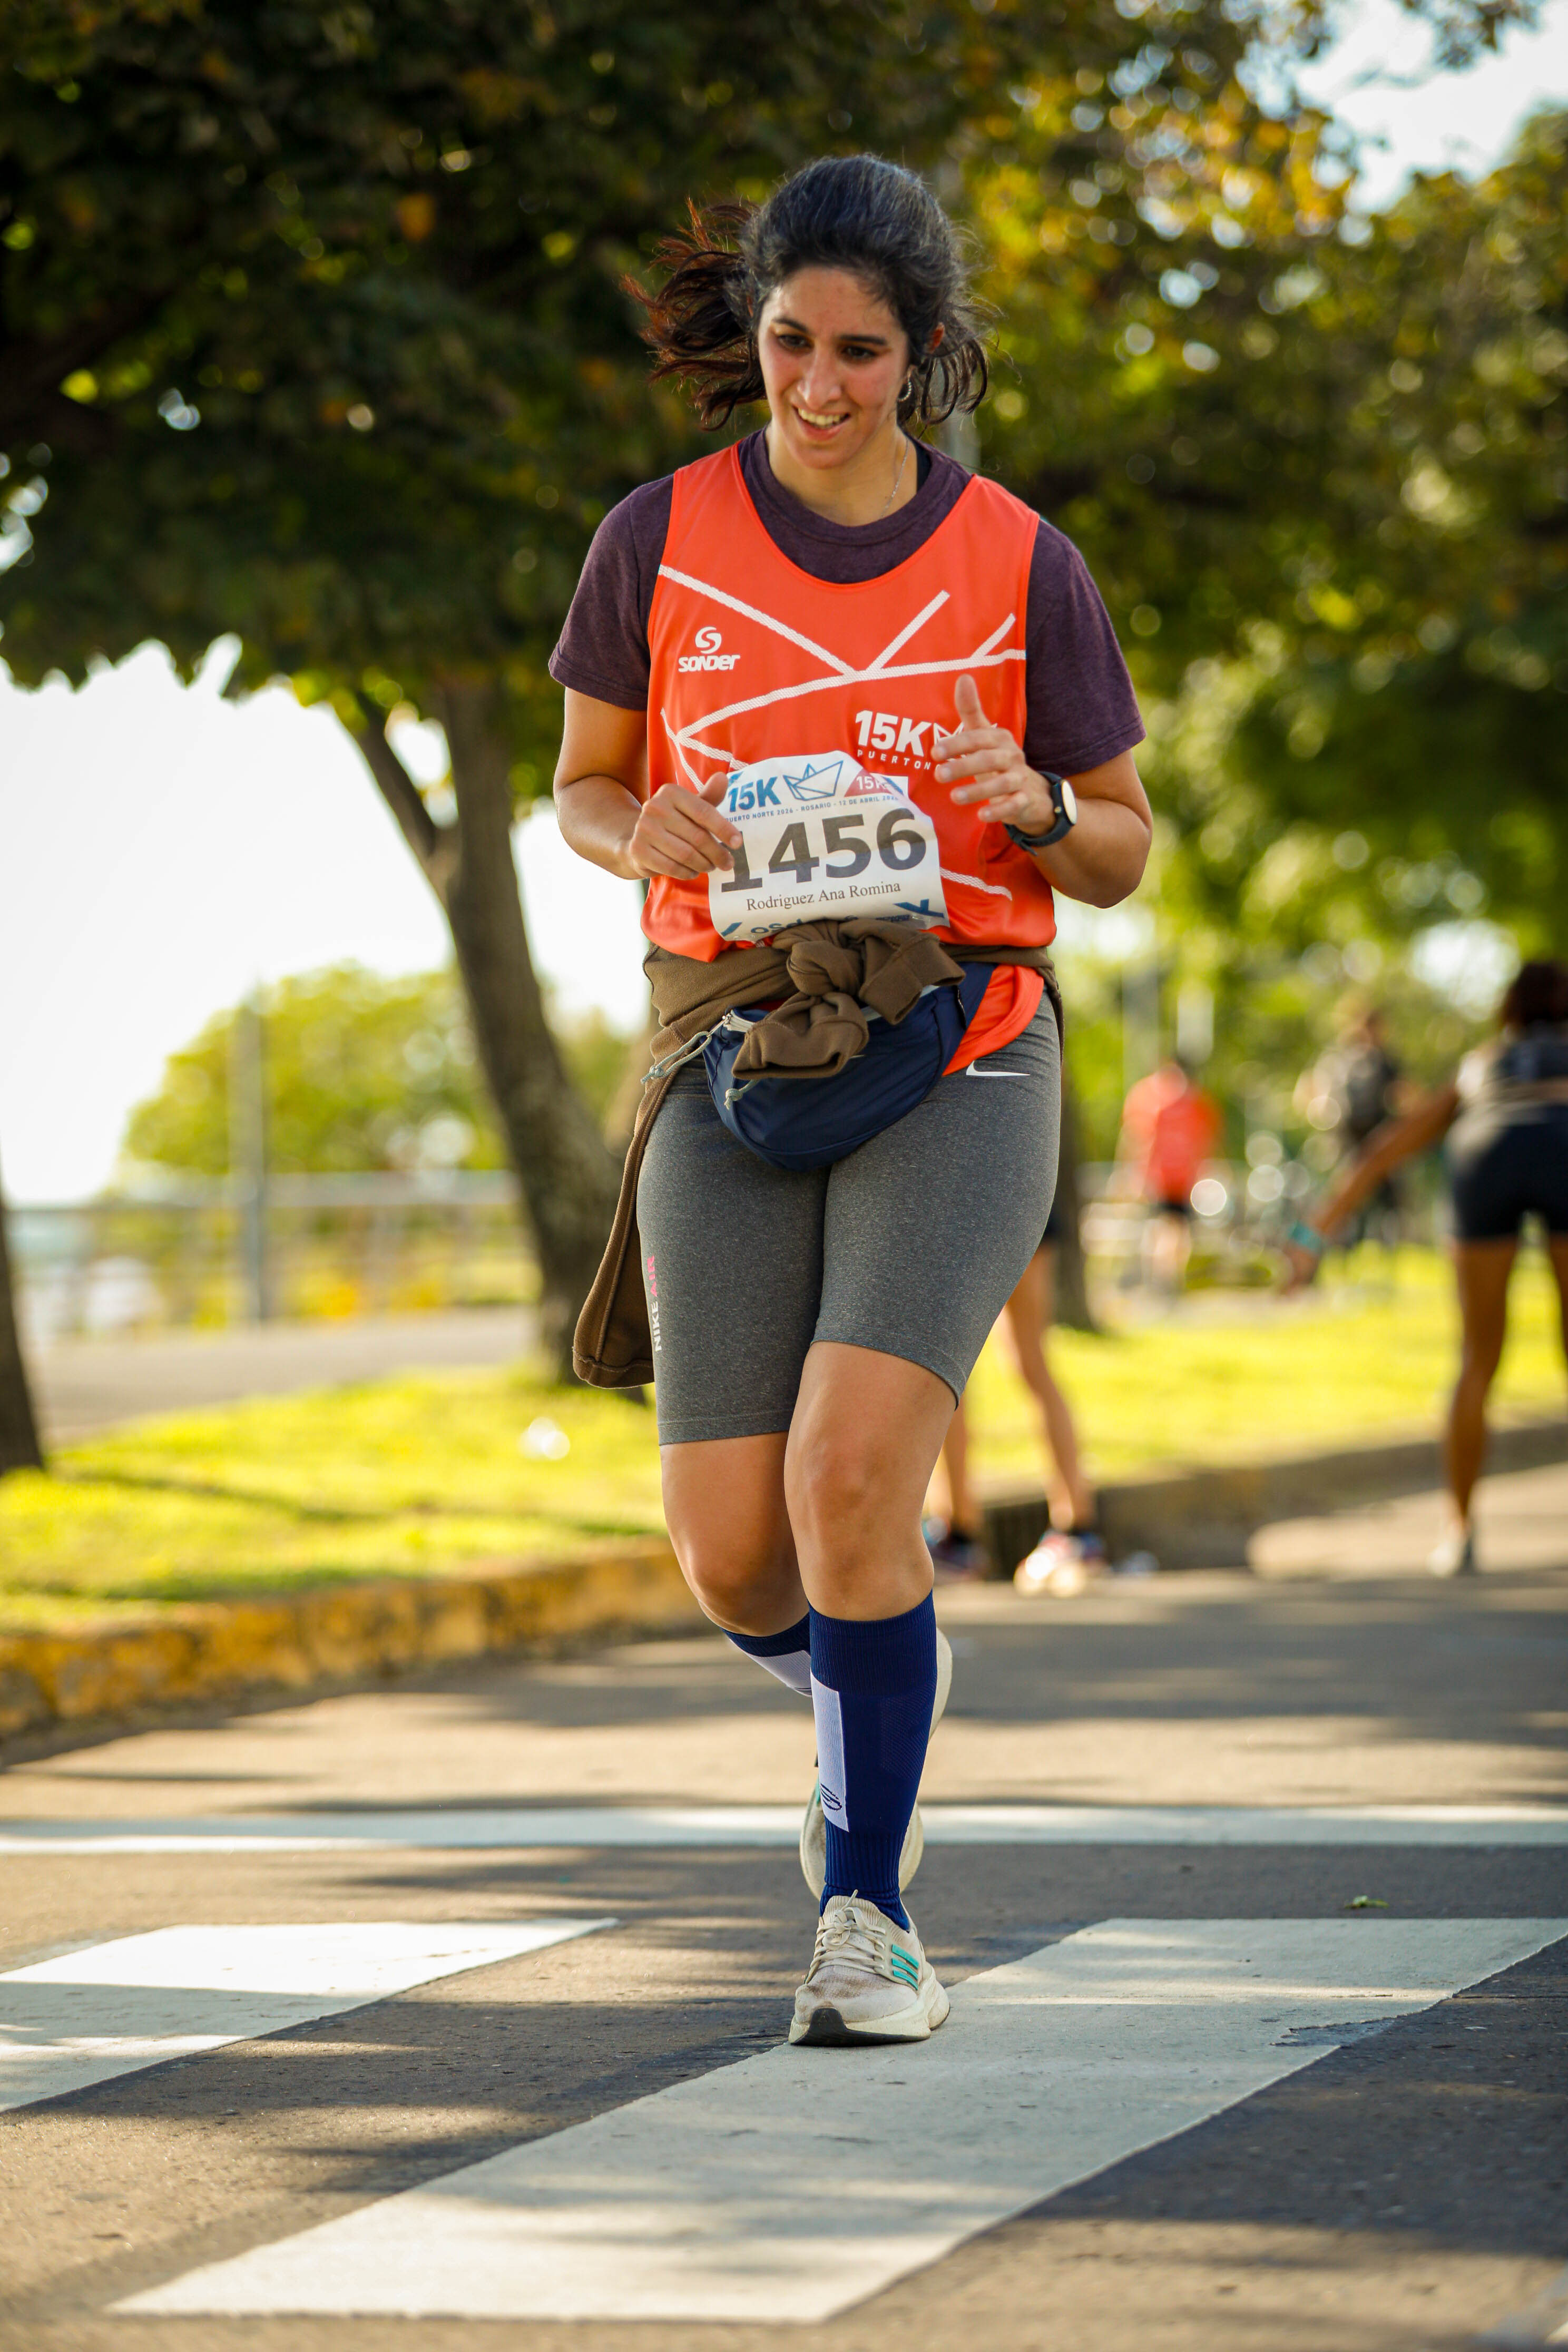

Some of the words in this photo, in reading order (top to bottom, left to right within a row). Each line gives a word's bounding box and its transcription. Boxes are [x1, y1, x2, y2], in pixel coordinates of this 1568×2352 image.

[855, 710, 932, 757] 15K
[728, 776, 782, 812] 15K
[752, 810, 775, 819] NORTE
[777, 808, 793, 816] 2026
[801, 802, 831, 811] ROSARIO
[721, 808, 927, 893] 1456
[746, 894, 815, 912] Rodriguez
[818, 889, 844, 902] Ana
[849, 881, 901, 898] Romina
[647, 1255, 658, 1297] AIR
[651, 1300, 662, 1352] NIKE
